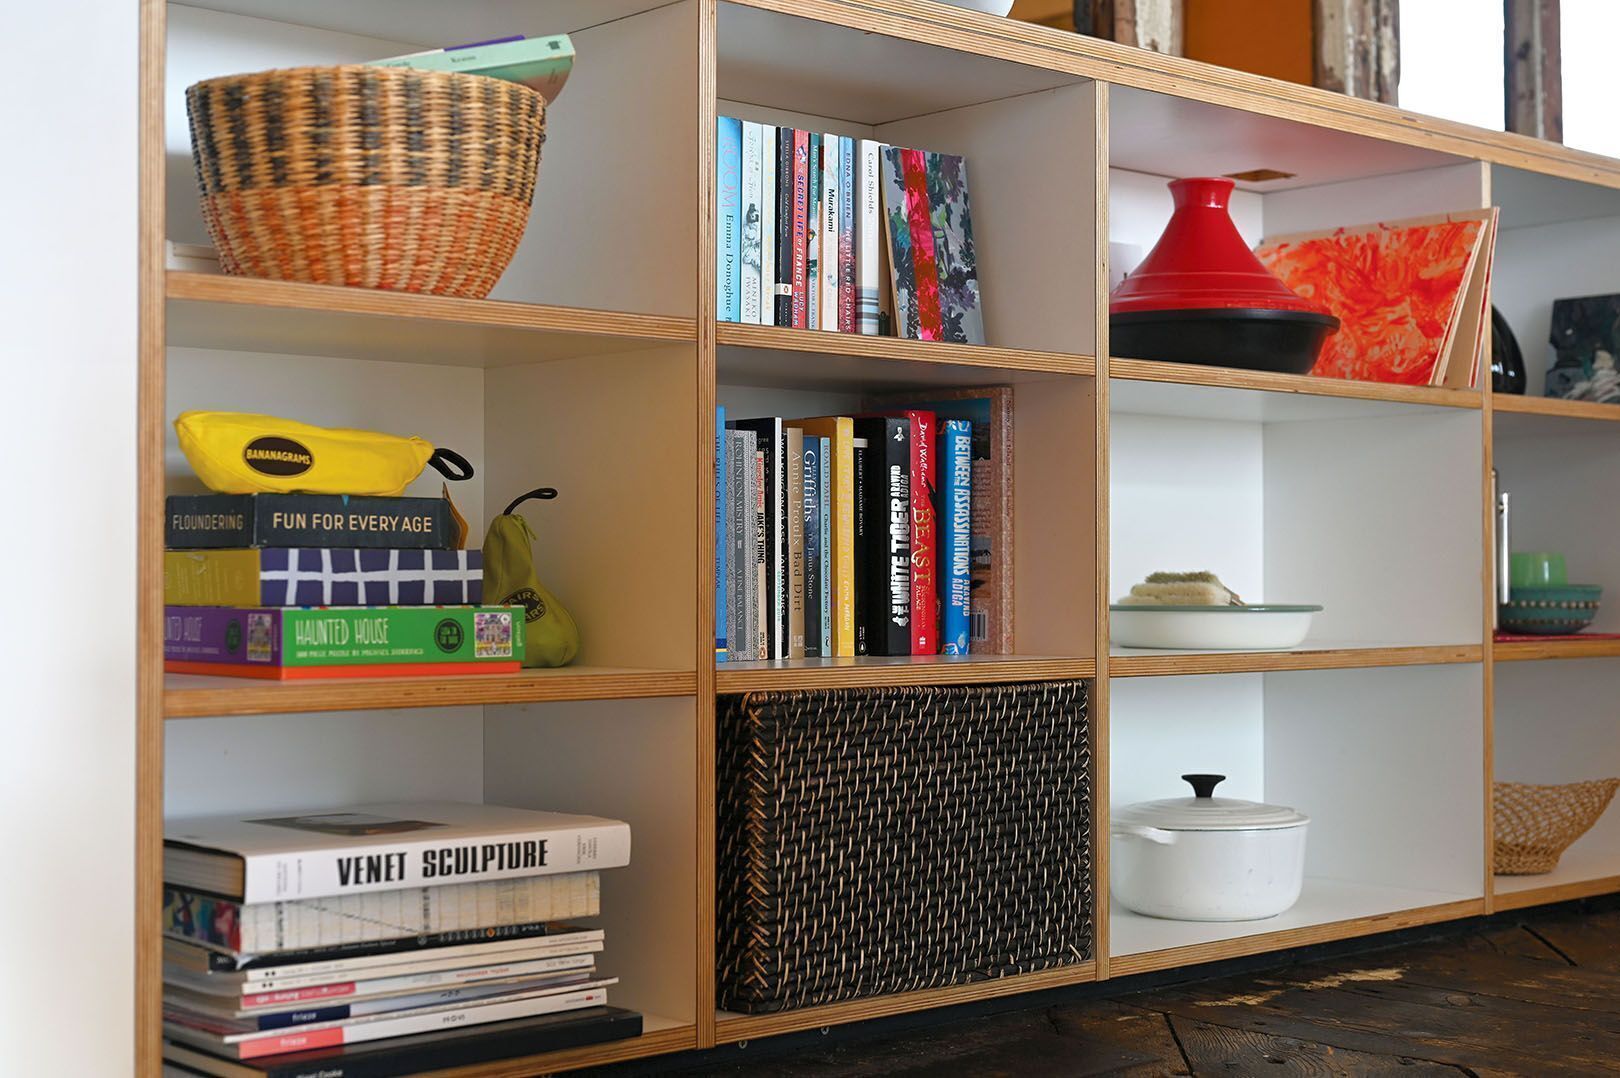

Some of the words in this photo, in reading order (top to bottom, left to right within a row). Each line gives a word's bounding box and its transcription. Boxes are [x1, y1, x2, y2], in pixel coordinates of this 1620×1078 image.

[797, 174, 805, 211] SECRET
[827, 188, 836, 232] Murakami
[867, 180, 875, 214] Shields
[725, 213, 733, 249] Emma
[722, 253, 734, 312] Donoghue
[795, 248, 803, 287] FRANCE
[918, 420, 928, 448] David
[246, 449, 310, 465] BANANAGRAMS
[735, 441, 743, 498] ROHINTON
[756, 457, 764, 489] Kingsley
[792, 451, 801, 494] Annie
[918, 448, 928, 488] Walliams
[954, 435, 971, 487] BETWEEN
[803, 450, 818, 522] Griffiths
[890, 465, 901, 497] ARAVIND
[900, 474, 909, 499] ADIGA
[172, 514, 244, 530] FLOUNDERING
[273, 512, 306, 529] FUN
[312, 513, 344, 531] FOR
[349, 514, 399, 532] EVERY
[401, 516, 432, 533] AGE
[735, 500, 743, 535] MISTRY
[793, 500, 801, 546] Proulx
[889, 498, 910, 553] TIGER
[952, 488, 971, 577] ASSASSINATIONS
[757, 540, 765, 564] THING
[793, 551, 802, 577] Bad
[911, 506, 931, 586] BEAST
[507, 591, 541, 604] AIRS
[793, 584, 802, 612] Dirt
[807, 573, 815, 600] Stone
[889, 555, 910, 605] WHITE
[952, 577, 964, 606] ADIGA
[962, 579, 970, 617] ARAVIND
[295, 618, 350, 645] HAUNTED
[354, 617, 389, 644] HOUSE
[337, 852, 408, 887] VENET
[422, 839, 548, 878] SCULPTURE
